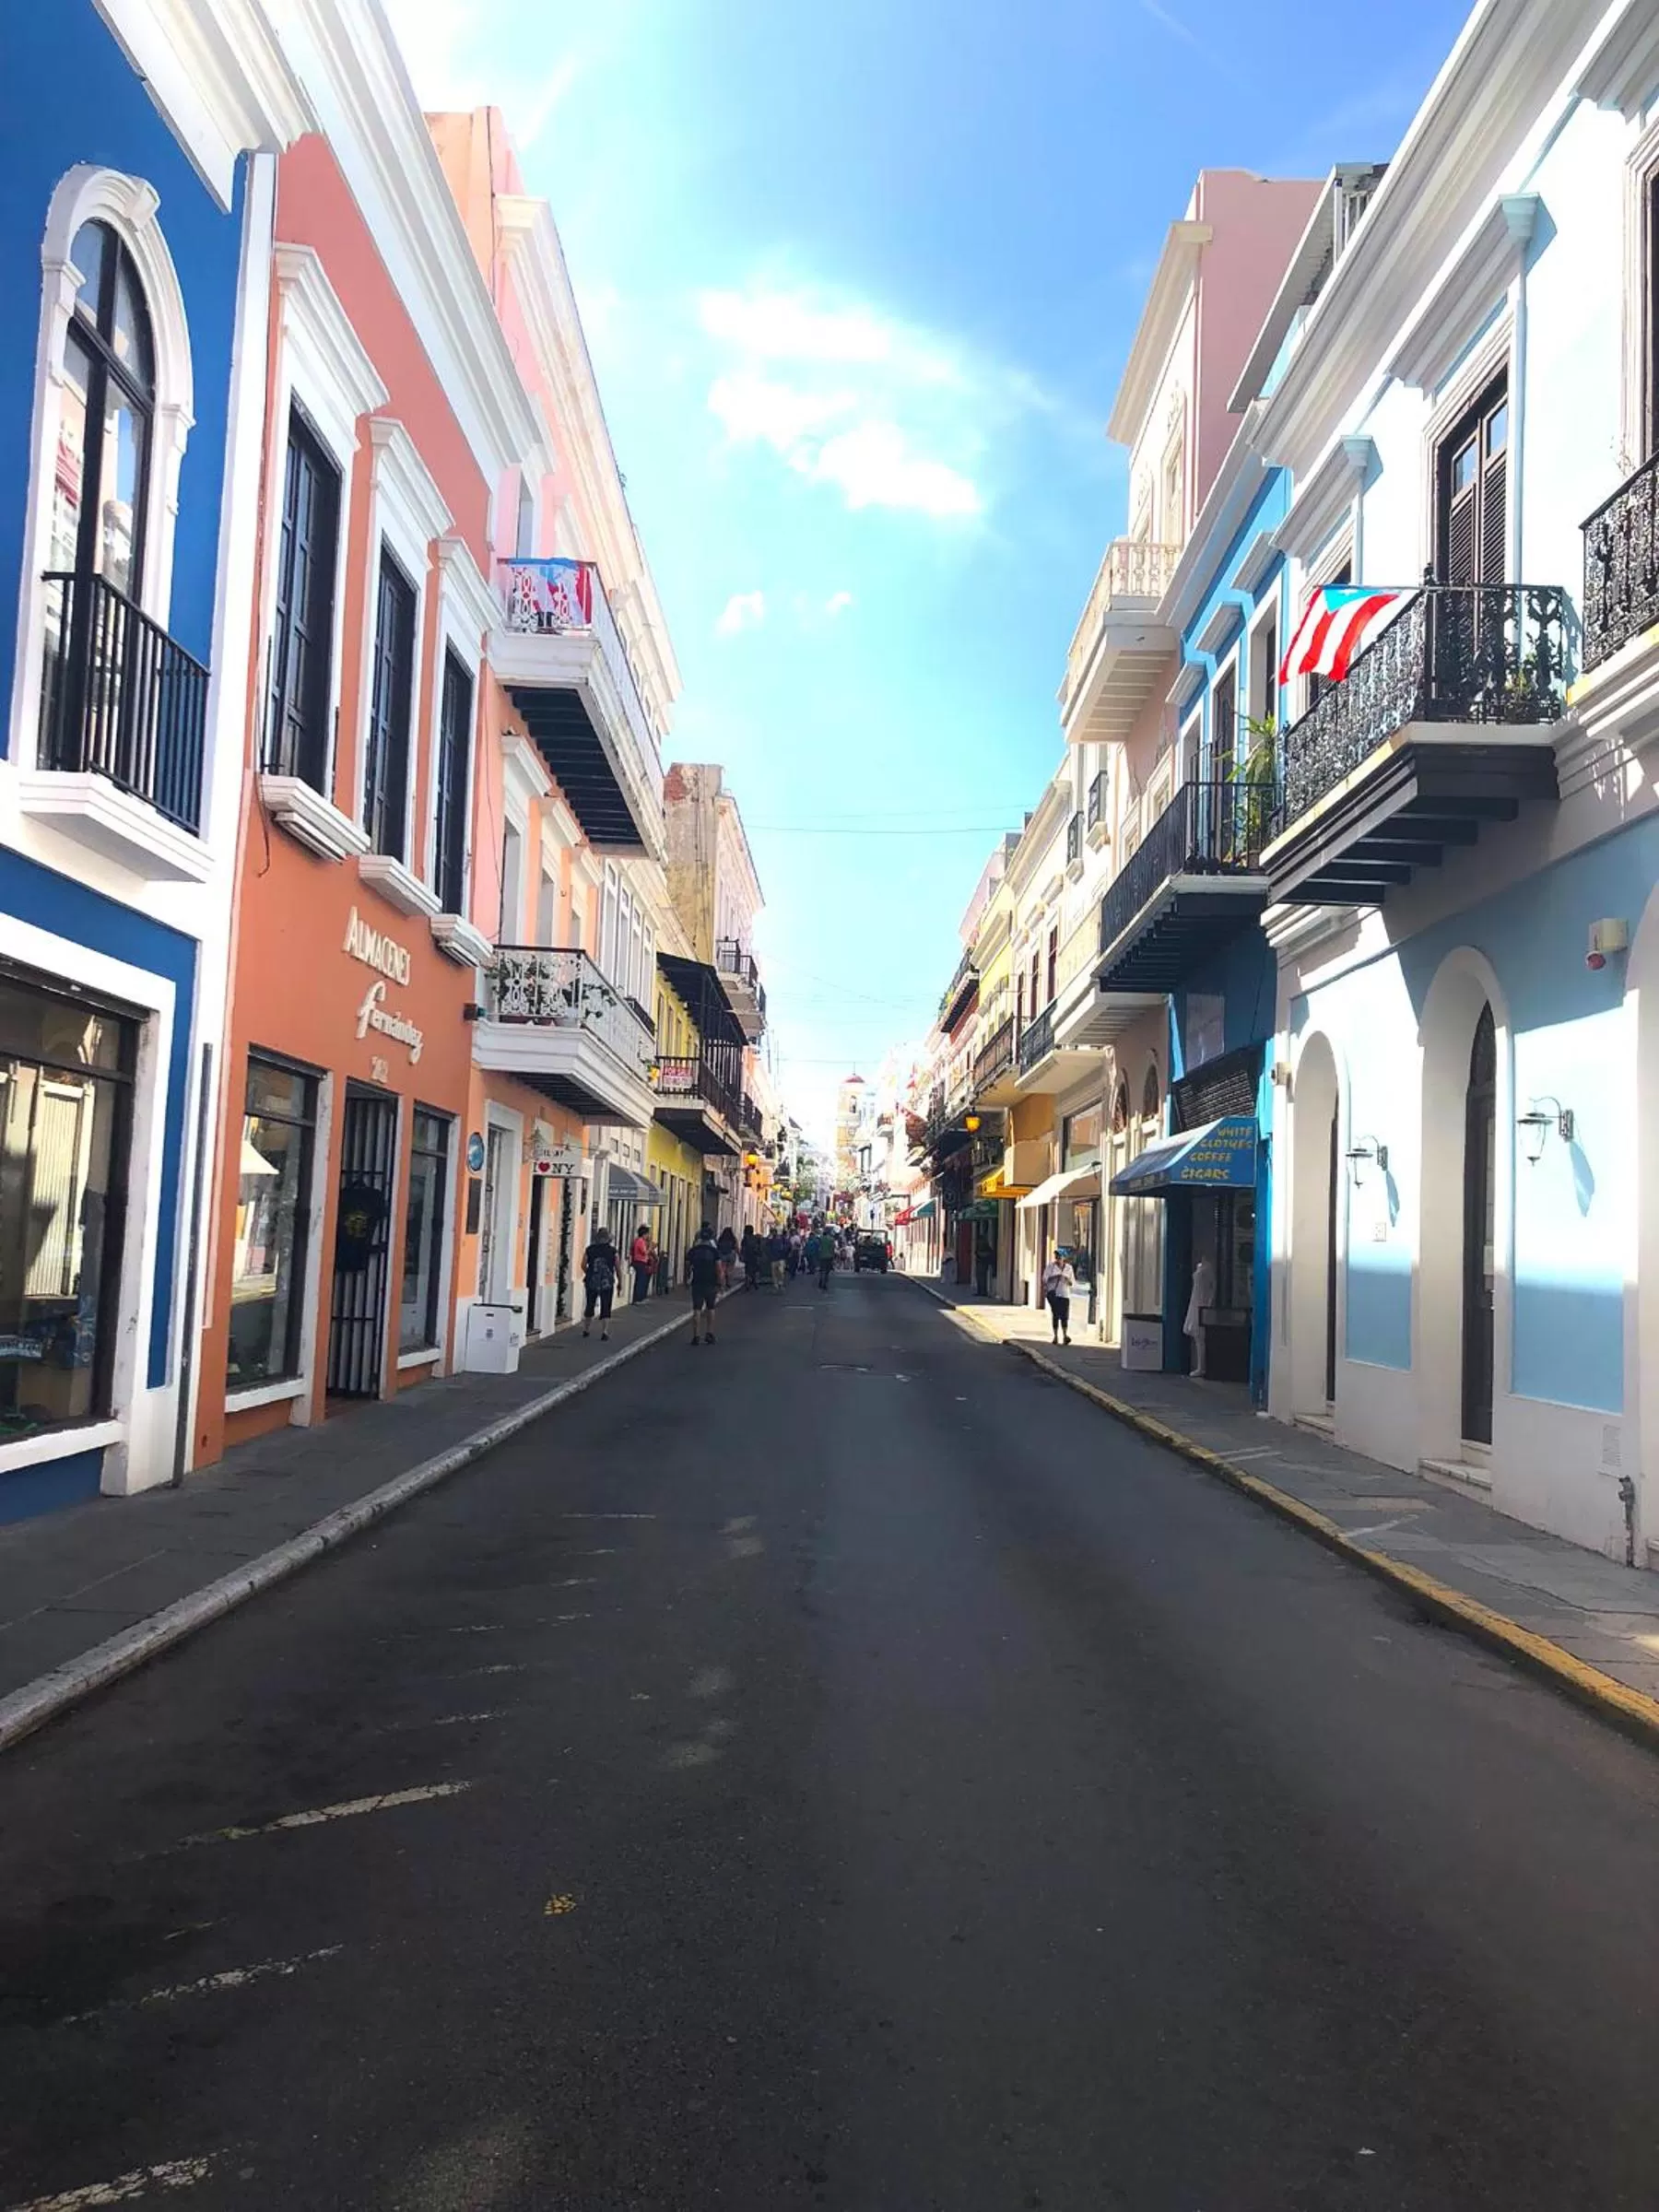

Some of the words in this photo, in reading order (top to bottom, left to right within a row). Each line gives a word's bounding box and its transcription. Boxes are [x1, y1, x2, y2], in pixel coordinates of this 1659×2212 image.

[342, 905, 410, 986] ALMACENES
[1218, 1125, 1253, 1137] WHITE
[1200, 1138, 1253, 1150] CLOTHES
[1189, 1151, 1232, 1162] COFFEE
[552, 1162, 575, 1174] NY
[1181, 1166, 1230, 1180] CIGARS
